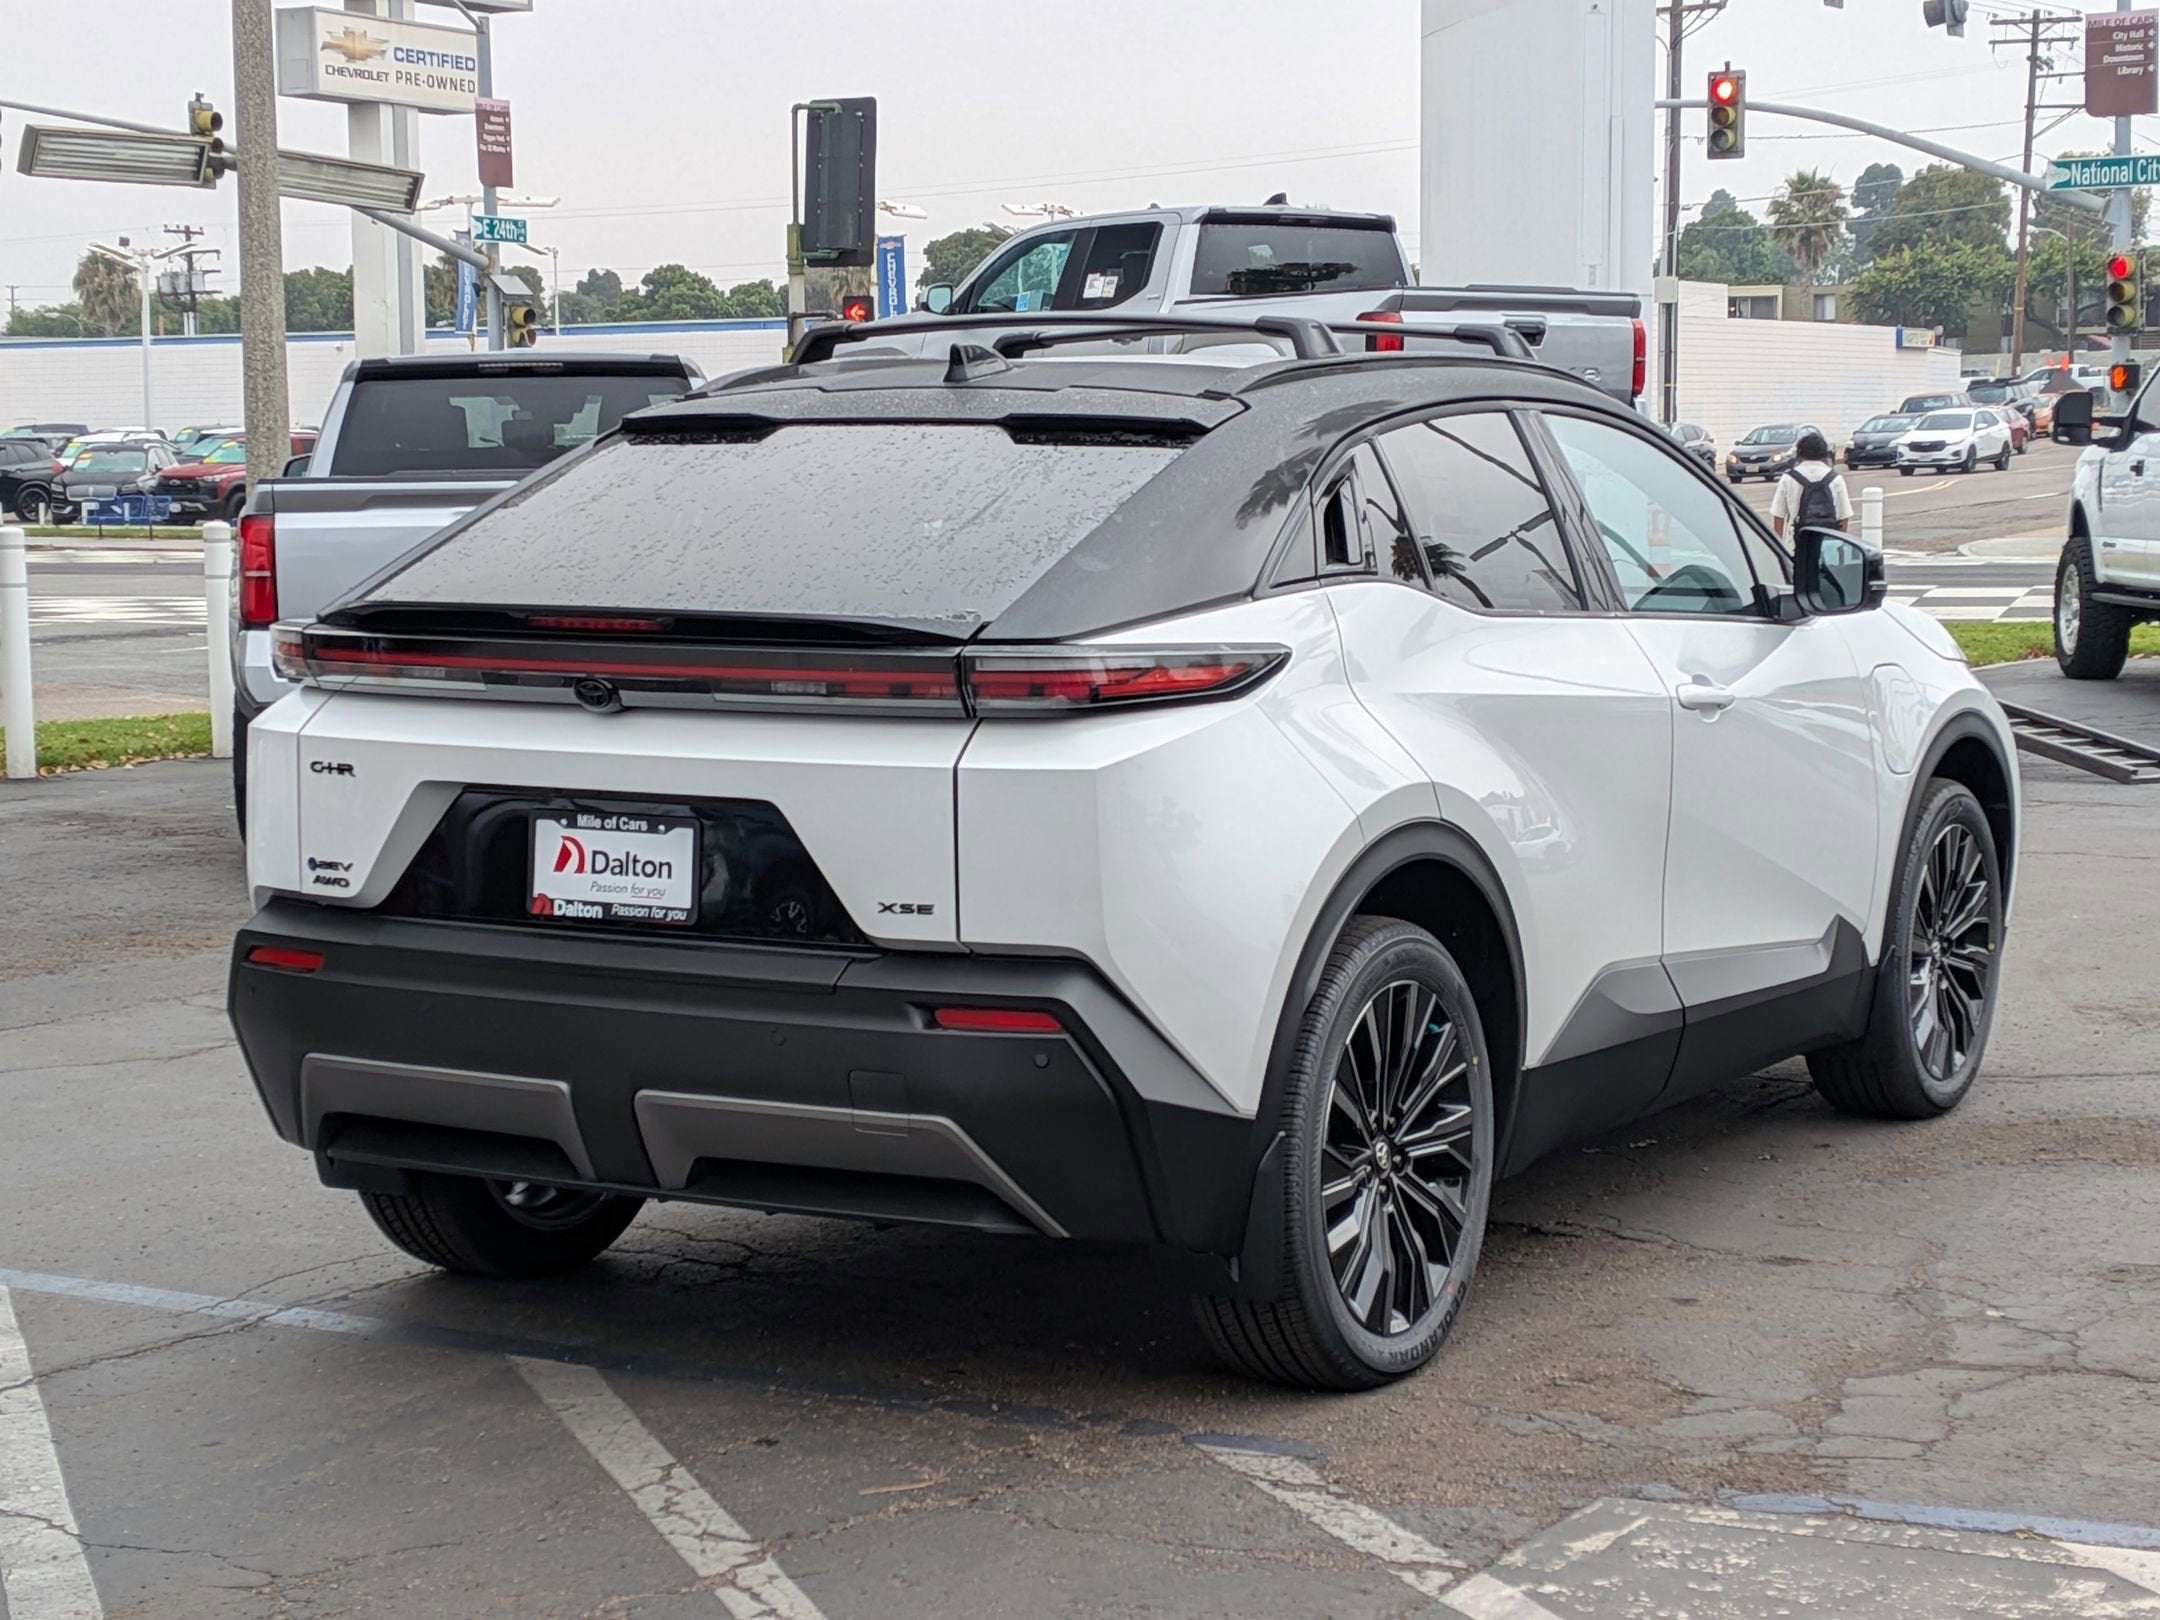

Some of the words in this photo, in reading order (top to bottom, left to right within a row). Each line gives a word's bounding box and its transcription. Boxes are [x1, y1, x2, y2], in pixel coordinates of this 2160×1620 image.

[2112, 31, 2128, 42] City
[2129, 28, 2145, 39] Hall
[393, 46, 476, 72] CERTIFIED
[324, 63, 390, 83] CHEVROLET
[2116, 65, 2145, 76] Library
[395, 70, 476, 94] PRE-OWNED
[2070, 159, 2134, 187] National
[482, 218, 493, 239] E
[493, 219, 518, 241] 24th
[576, 813, 601, 828] Mile
[603, 815, 617, 829] of
[618, 816, 648, 832] Cars
[591, 849, 673, 880] Dalton
[590, 881, 628, 895] Passion
[630, 883, 645, 896] for
[647, 887, 666, 898] you
[553, 899, 604, 919] Dalton
[610, 903, 649, 919] Passion
[650, 905, 666, 919] for
[666, 909, 688, 922] you
[877, 901, 936, 916] XSE
